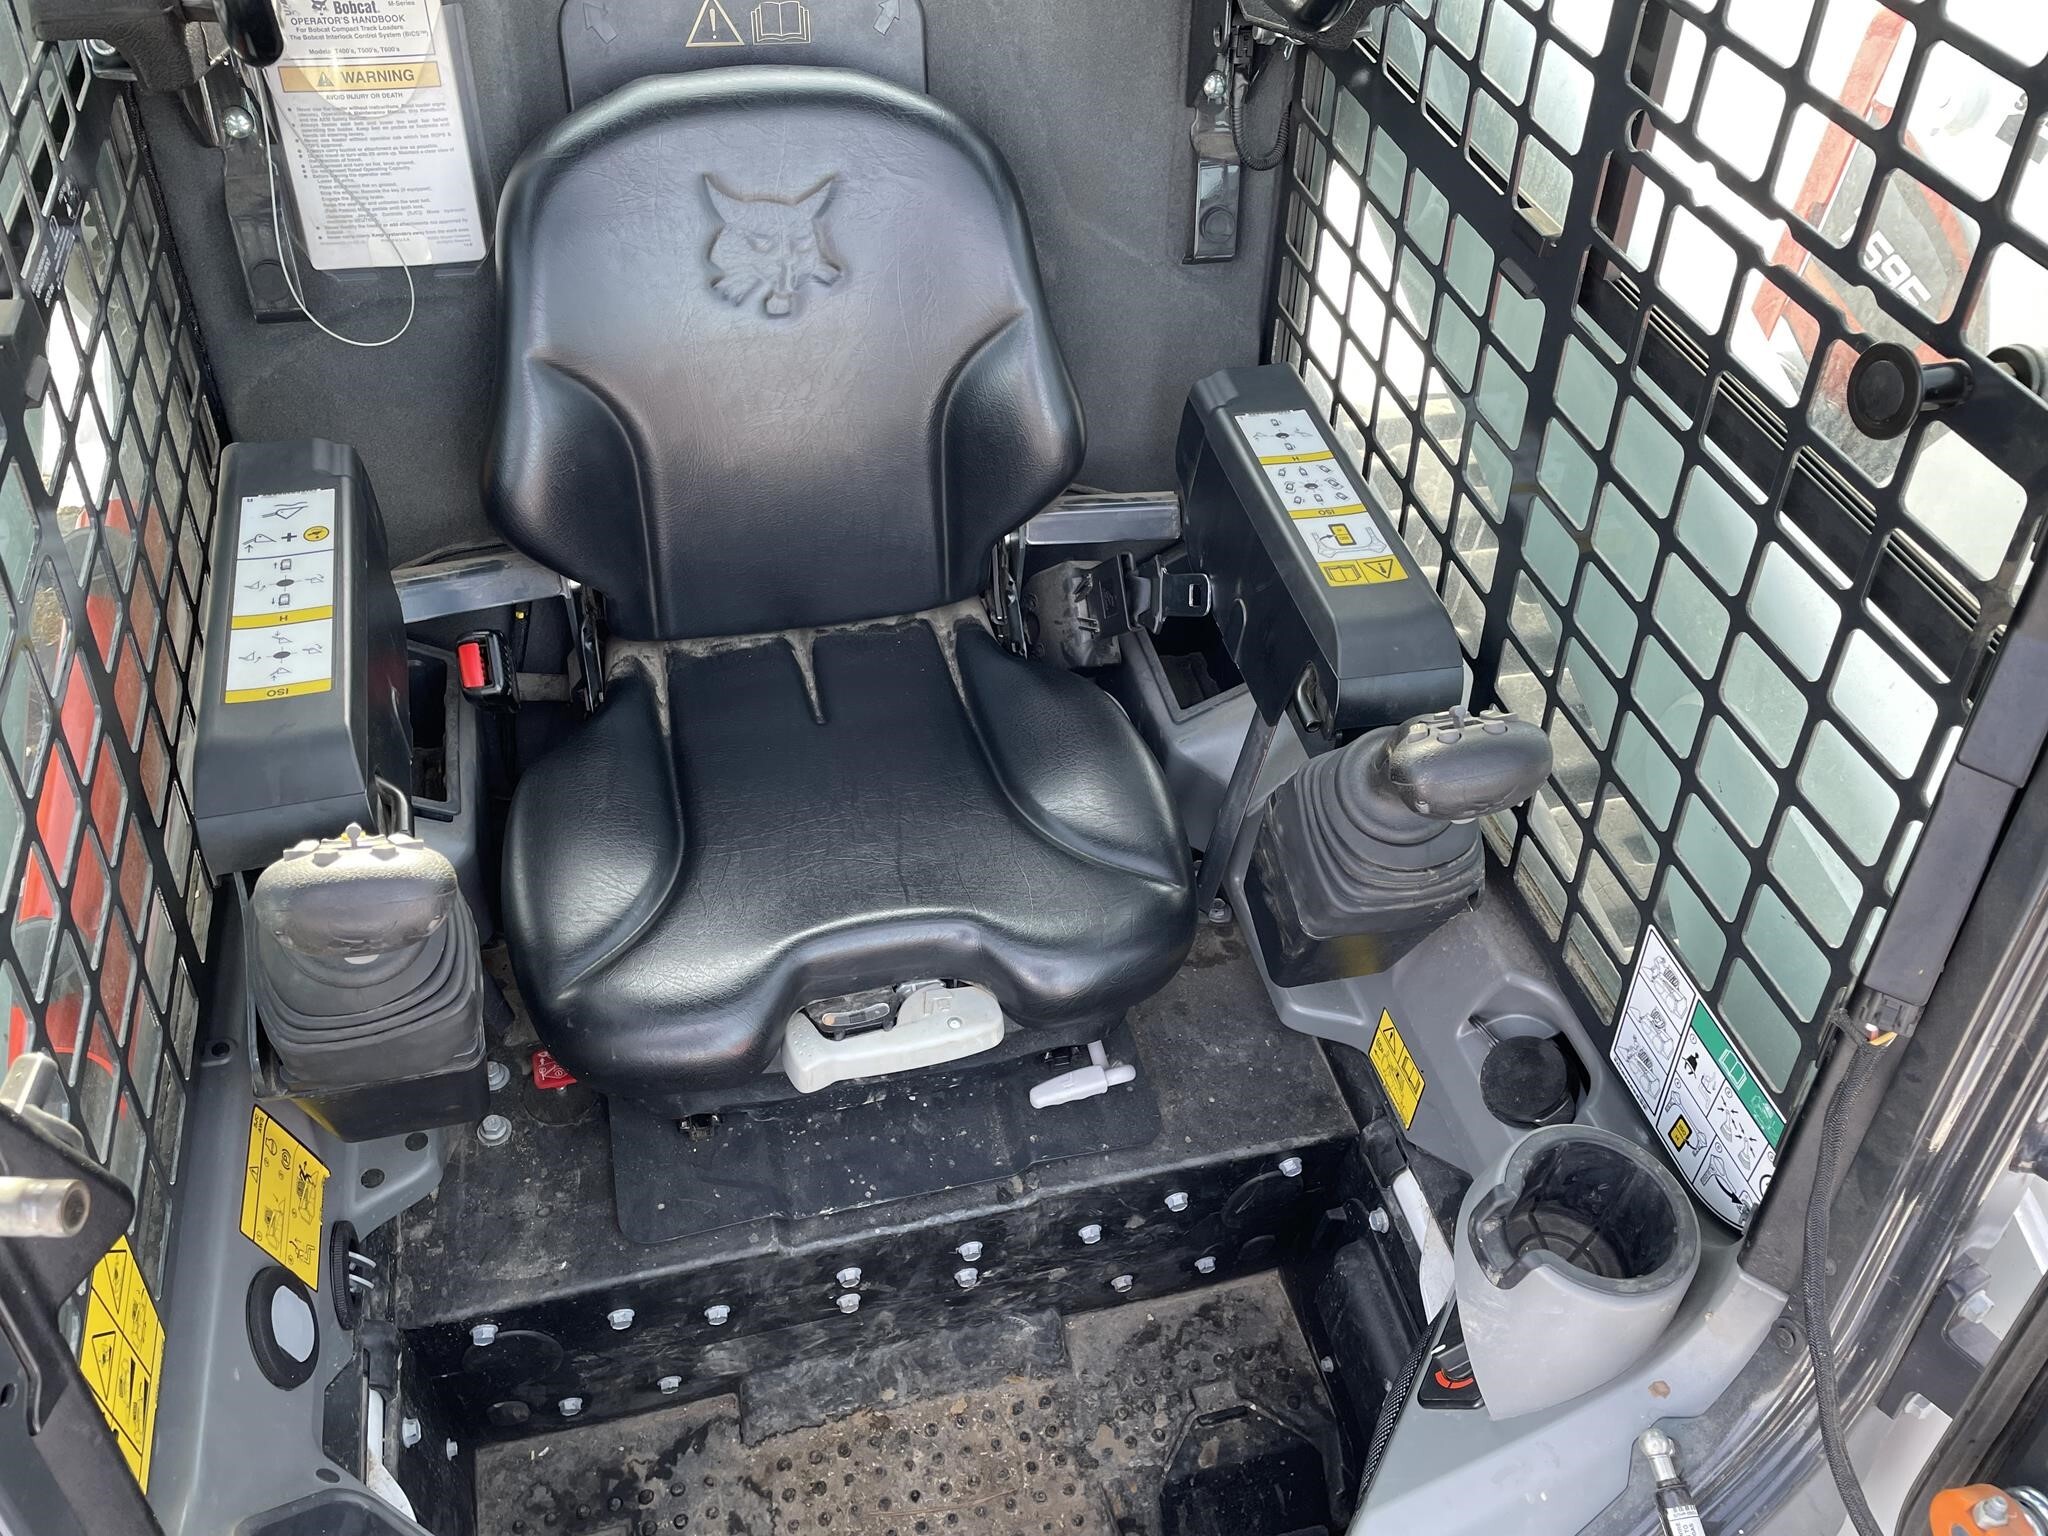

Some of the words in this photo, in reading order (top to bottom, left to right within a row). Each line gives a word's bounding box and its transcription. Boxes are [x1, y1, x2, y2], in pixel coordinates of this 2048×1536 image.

[333, 0, 377, 15] Bobcat
[290, 15, 350, 26] OPERATOR'S
[352, 14, 406, 24] HANDBOOK
[341, 69, 415, 83] WARNING
[382, 91, 404, 99] DEATH
[266, 687, 289, 697] ISO
